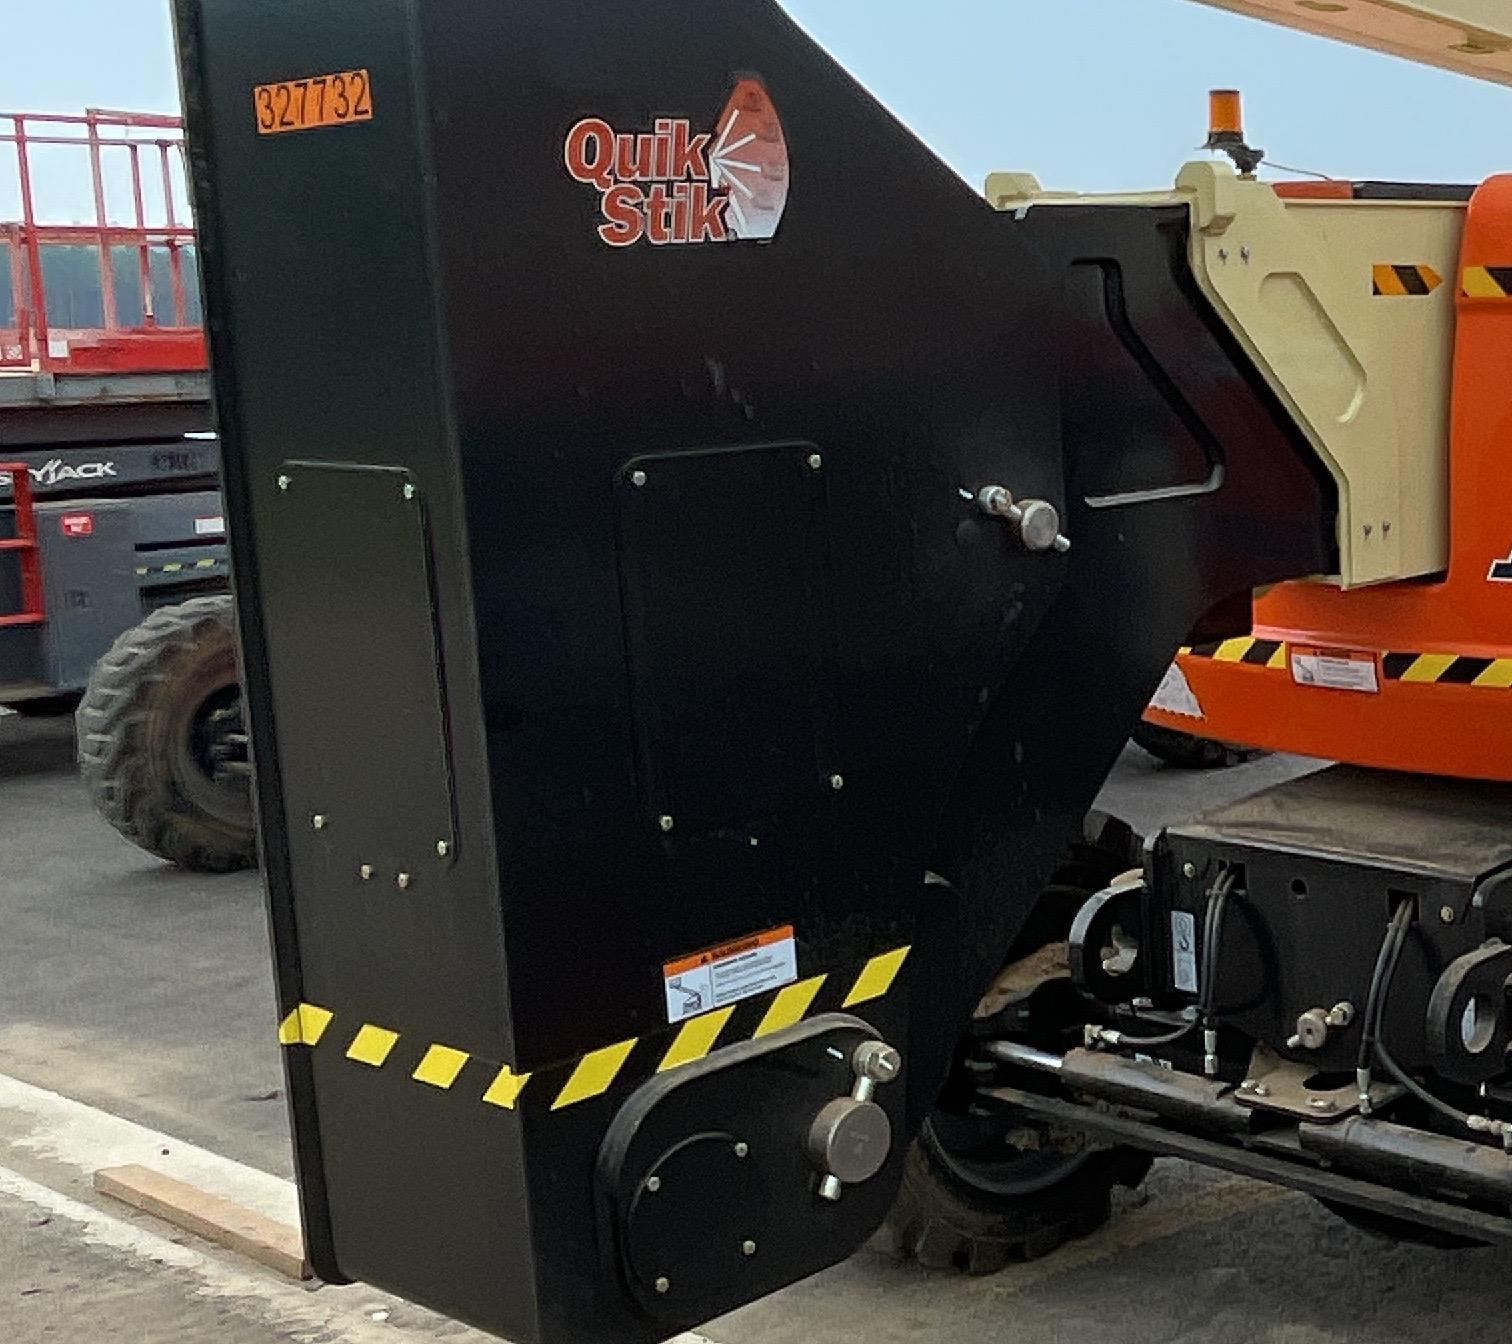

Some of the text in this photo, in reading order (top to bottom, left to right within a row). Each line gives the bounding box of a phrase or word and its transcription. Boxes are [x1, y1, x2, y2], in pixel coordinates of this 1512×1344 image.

[257, 71, 370, 130] 327732
[564, 117, 712, 190] Quik
[598, 183, 729, 246] Stik
